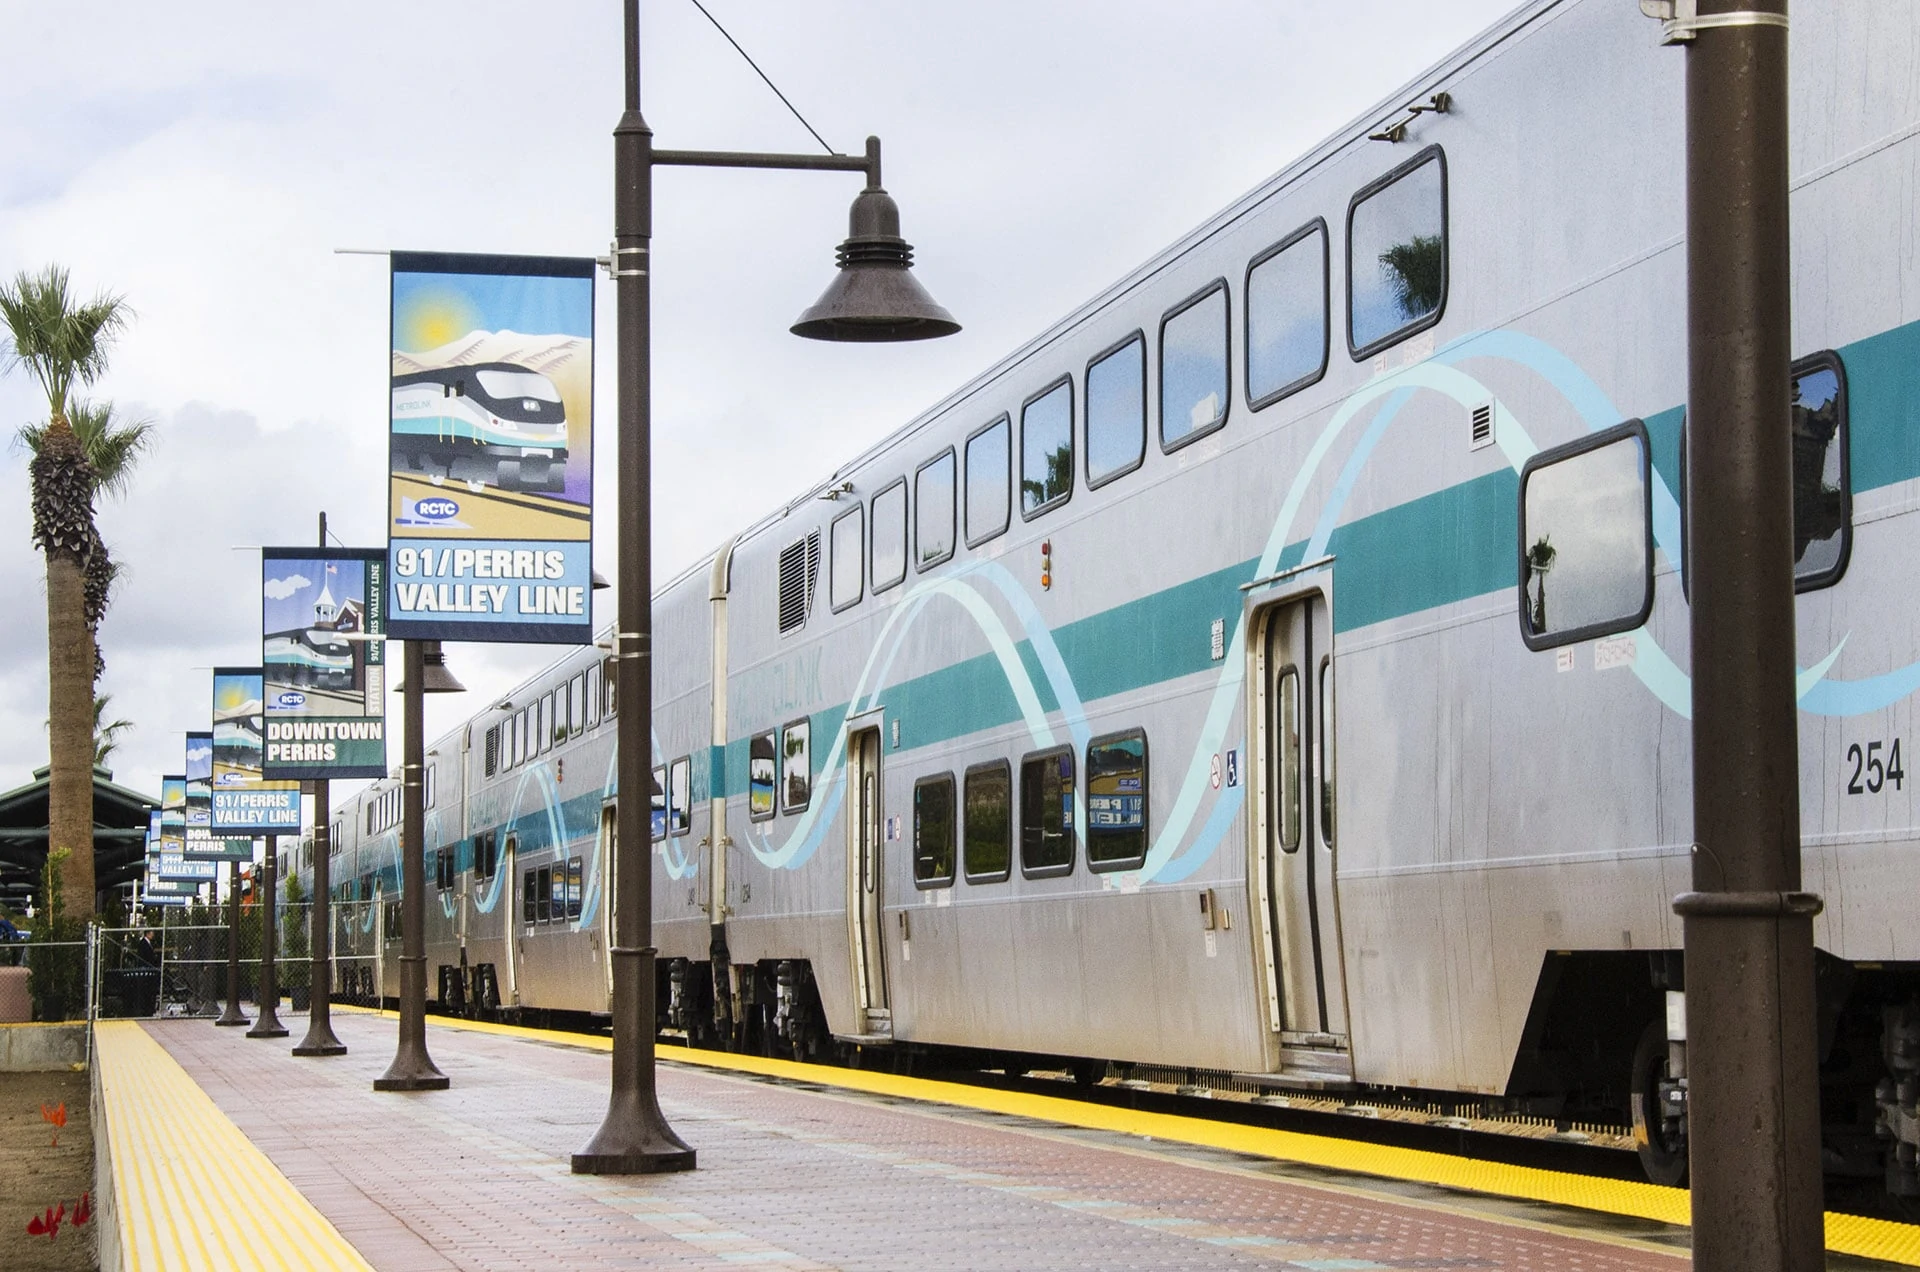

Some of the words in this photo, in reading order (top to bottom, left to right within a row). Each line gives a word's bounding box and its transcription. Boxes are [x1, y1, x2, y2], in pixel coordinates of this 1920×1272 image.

[419, 502, 455, 515] RCTC
[396, 548, 565, 579] 91/PERRIS
[371, 564, 380, 584] LINE
[371, 586, 379, 618] VALLEY
[396, 582, 510, 613] VALLEY
[518, 585, 584, 615] LINE
[371, 620, 379, 662] 91/PERIS
[370, 668, 380, 713] STATION
[267, 722, 382, 741] DOWNTOWN
[267, 743, 337, 761] PERRIS
[1846, 737, 1905, 796] 254
[215, 794, 289, 808] 91/PERRIS
[215, 809, 264, 823] VALLEY
[268, 809, 297, 823] LINE
[186, 841, 226, 851] PERRIS
[162, 865, 193, 875] VALLEY
